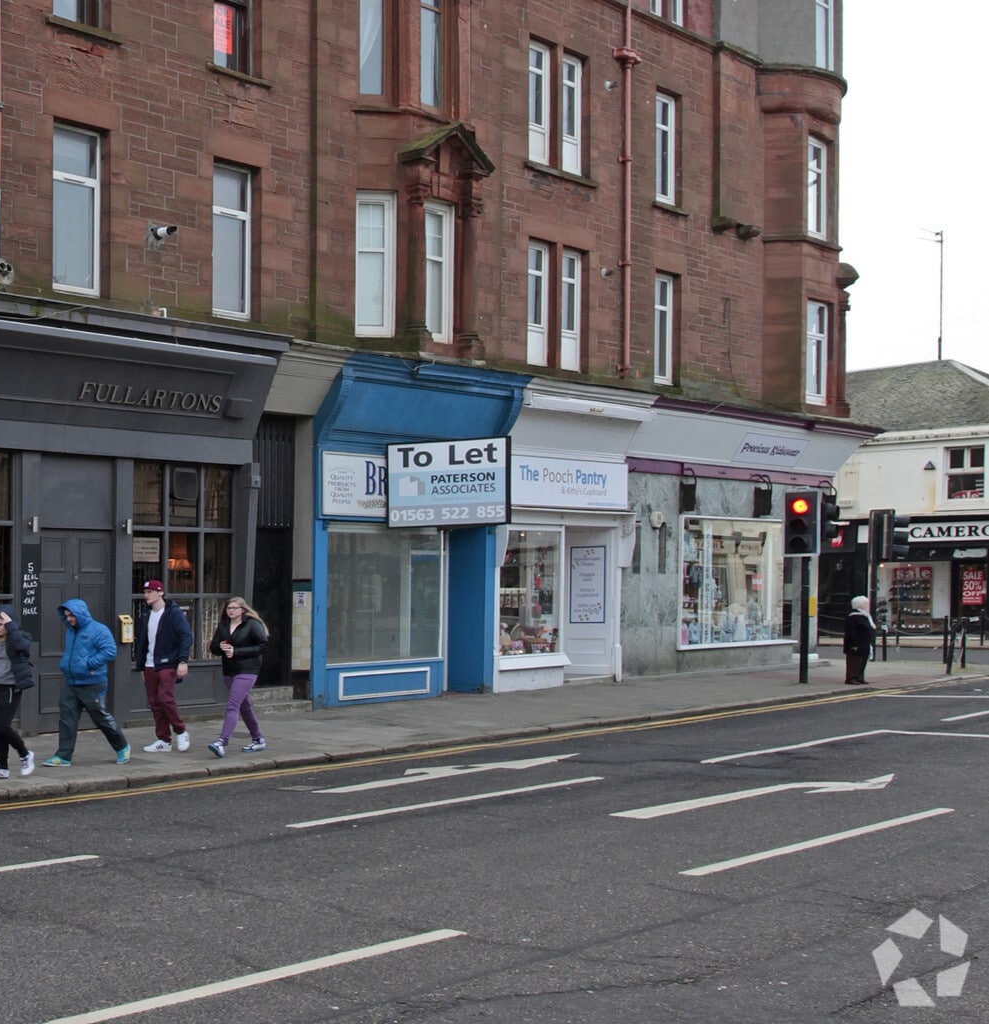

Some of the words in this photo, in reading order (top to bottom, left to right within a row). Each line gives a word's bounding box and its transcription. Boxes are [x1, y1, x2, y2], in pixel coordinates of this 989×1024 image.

[79, 381, 223, 413] FULLARTONS
[397, 447, 433, 468] To
[448, 443, 498, 465] Let
[430, 472, 496, 484] PATERSON
[519, 465, 539, 481] The
[543, 468, 573, 484] Pooch
[576, 470, 607, 488] Pantry
[431, 483, 496, 495] ASSOCIATES
[583, 487, 607, 496] Cupboard
[391, 508, 434, 522] 01563
[441, 507, 469, 519] 522
[476, 505, 505, 518] 855
[896, 566, 931, 580] sale
[963, 571, 983, 580] SALE
[963, 580, 982, 591] 50%
